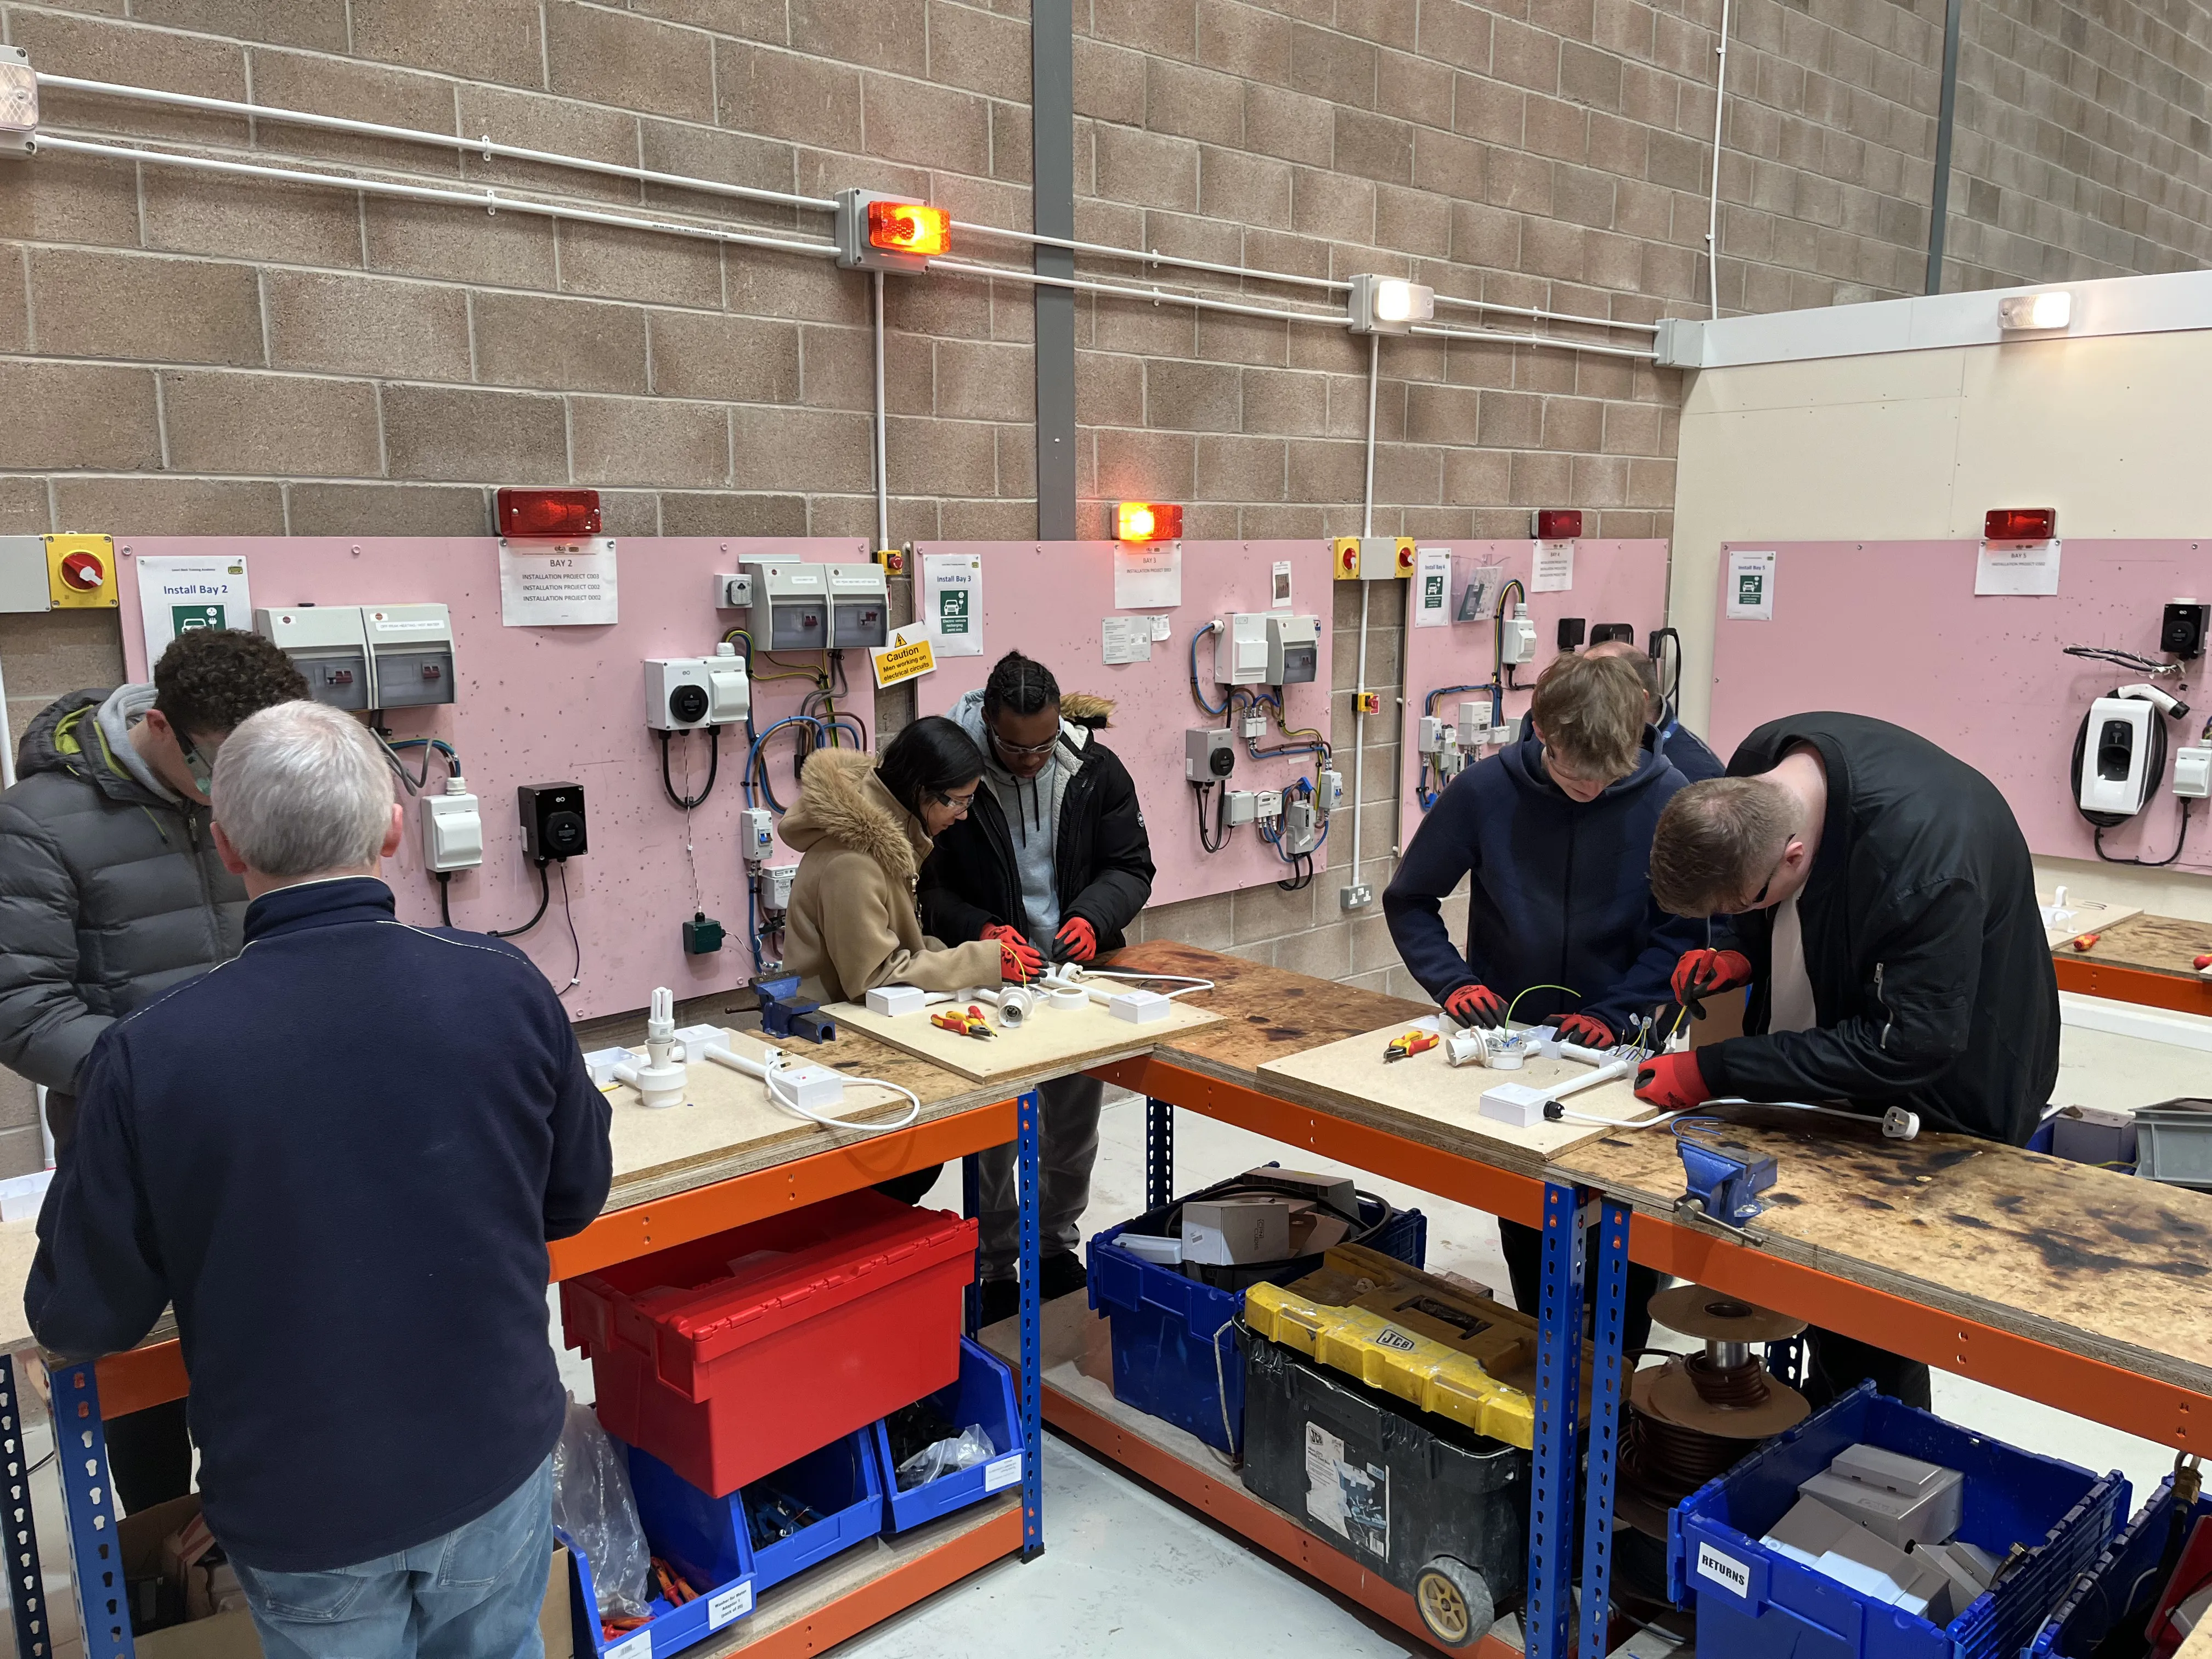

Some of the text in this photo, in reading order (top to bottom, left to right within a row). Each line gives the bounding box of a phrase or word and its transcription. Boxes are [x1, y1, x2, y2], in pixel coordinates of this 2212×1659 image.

[164, 585, 228, 595] Install Bay 2
[887, 647, 919, 662] Caution
[883, 665, 895, 673] Men
[896, 657, 918, 668] working
[884, 662, 929, 681] electrical circuits
[1381, 1333, 1410, 1348] JCB
[1311, 1429, 1323, 1444] JCB
[1702, 1554, 1745, 1585] RETURNS
